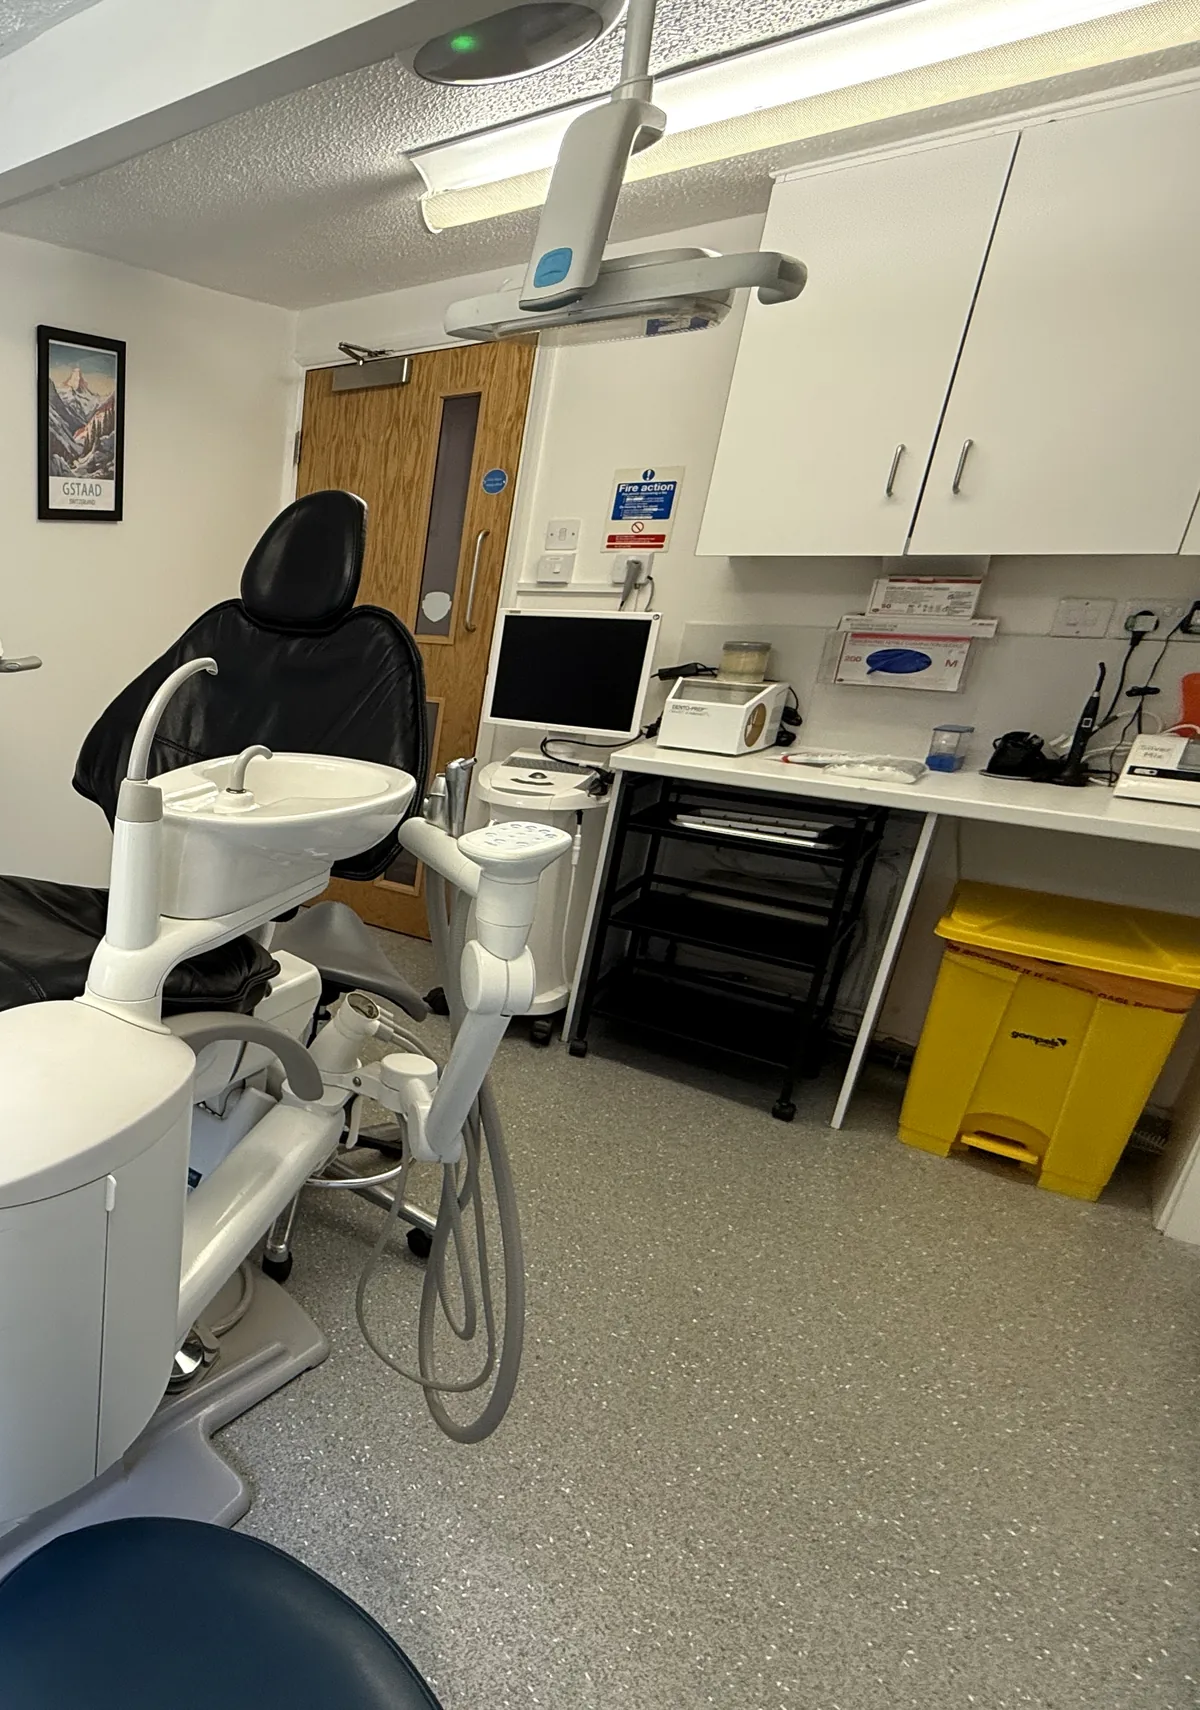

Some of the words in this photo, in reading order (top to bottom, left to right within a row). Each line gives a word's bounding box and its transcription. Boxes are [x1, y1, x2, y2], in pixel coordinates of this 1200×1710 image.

[62, 482, 102, 497] GSTAAD
[618, 483, 639, 492] Fire
[640, 482, 674, 492] action
[844, 655, 862, 663] 200
[945, 659, 959, 668] M
